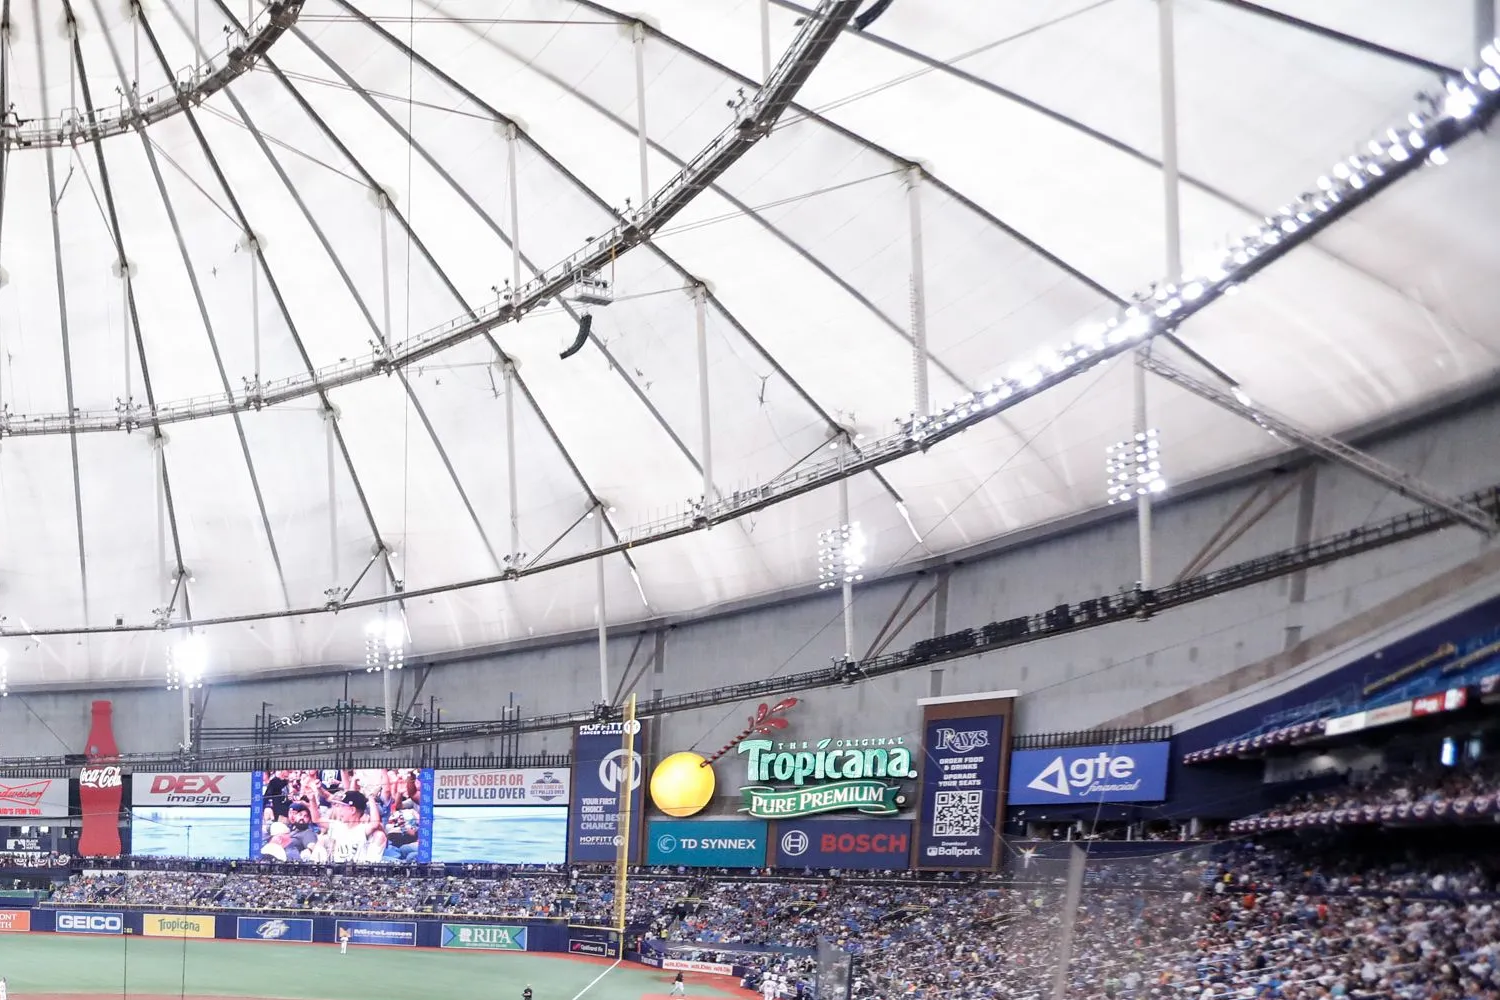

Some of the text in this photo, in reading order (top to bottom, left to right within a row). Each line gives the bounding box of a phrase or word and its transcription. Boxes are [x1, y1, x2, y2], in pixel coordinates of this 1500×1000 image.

[778, 737, 904, 750] THE ORIGINAL
[935, 728, 989, 753] RAYS
[738, 739, 911, 785] Tropicana
[1069, 752, 1135, 787] gte
[150, 775, 226, 794] DEX
[440, 775, 523, 786] DRIVE SOBER OR
[1079, 778, 1141, 796] financial
[167, 793, 230, 804] imaging
[437, 789, 526, 800] GET PULLED OVER
[751, 786, 884, 814] PURE PREMIUM
[581, 814, 626, 822] YOUR BEST
[681, 839, 756, 850] TD SYNNEX
[820, 834, 907, 853] BOSCH
[938, 847, 981, 857] Ballpark
[59, 915, 121, 930] GEICO
[158, 919, 200, 932] Tropicana
[354, 928, 412, 938] MicroLumen
[470, 928, 512, 943] RIPA
